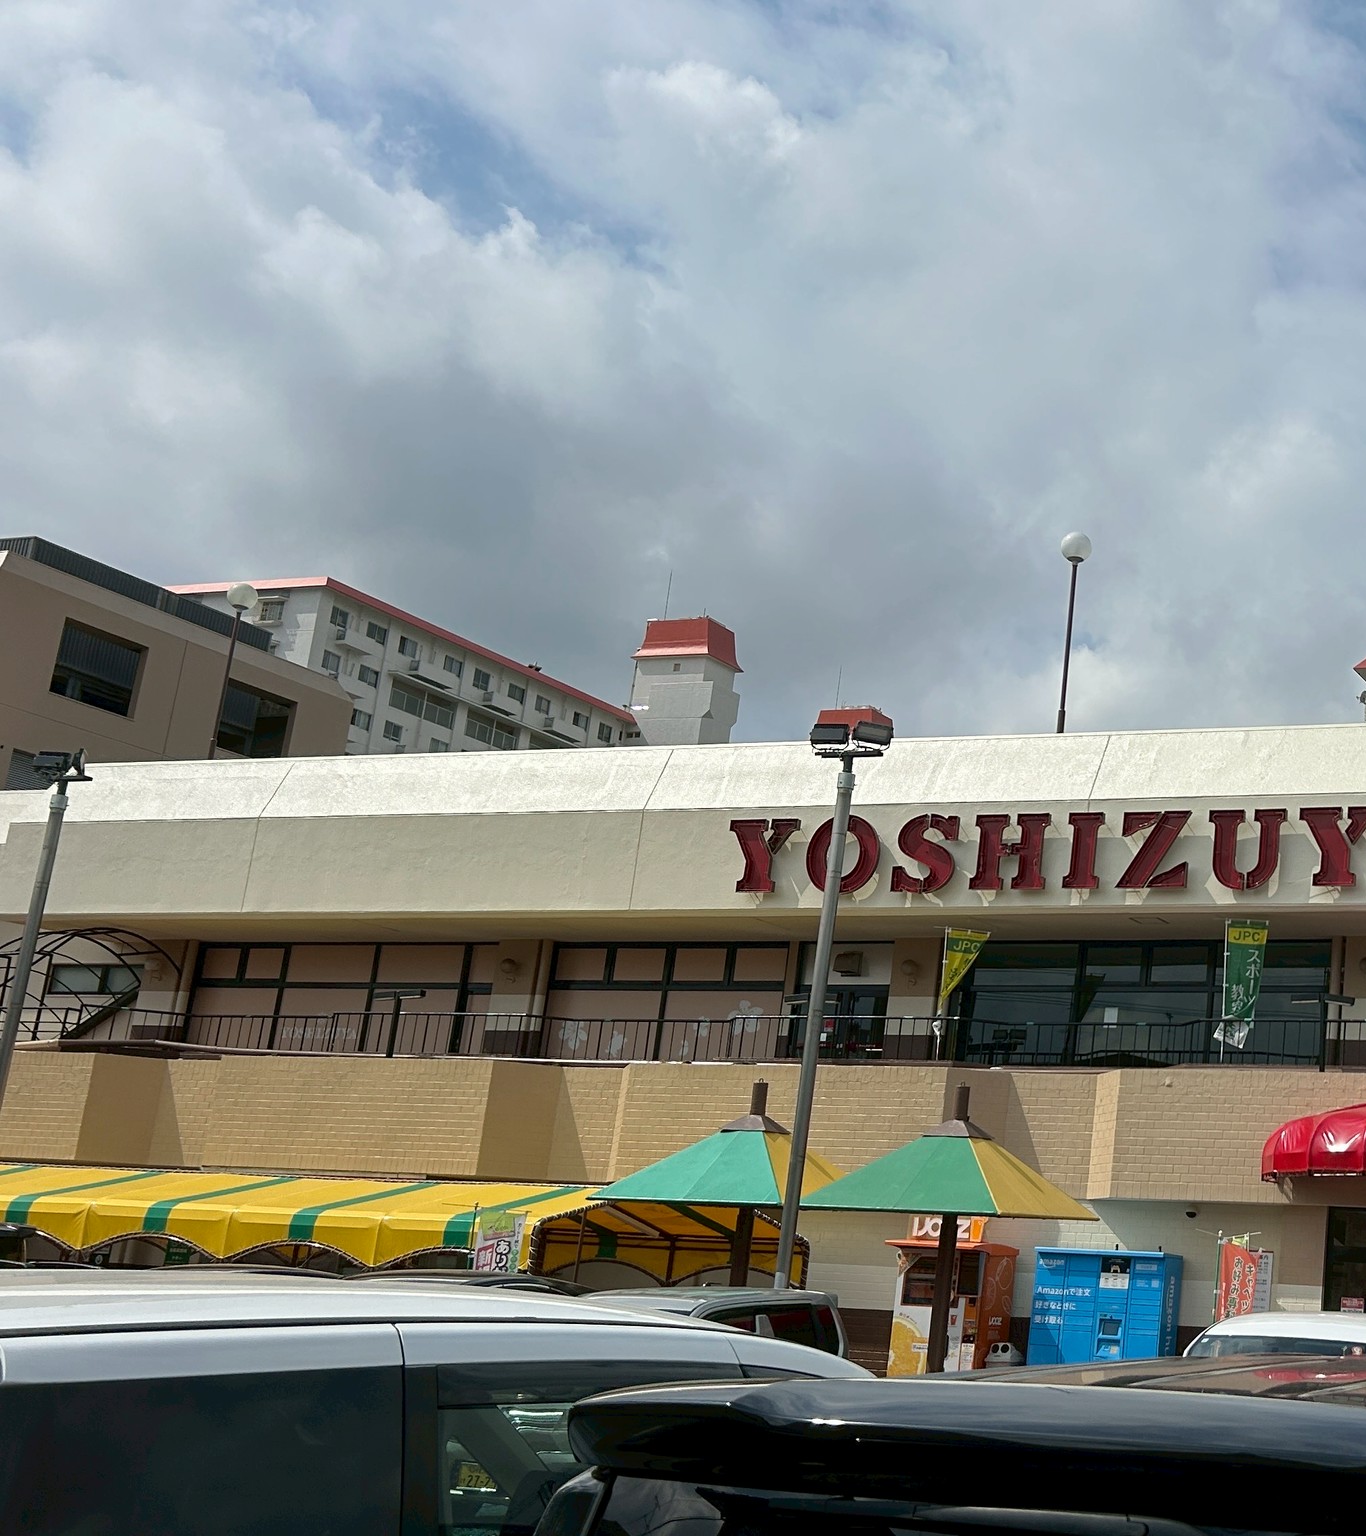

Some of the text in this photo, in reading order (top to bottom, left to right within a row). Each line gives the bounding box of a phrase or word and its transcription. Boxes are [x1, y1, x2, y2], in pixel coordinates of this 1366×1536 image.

[1233, 930, 1261, 942] JPC
[953, 940, 980, 953] JPC
[1238, 949, 1261, 1011] スポーツ
[912, 1216, 971, 1239] IJOZ
[1039, 1258, 1065, 1268] amazon
[1035, 1285, 1091, 1297] Amazonで注文
